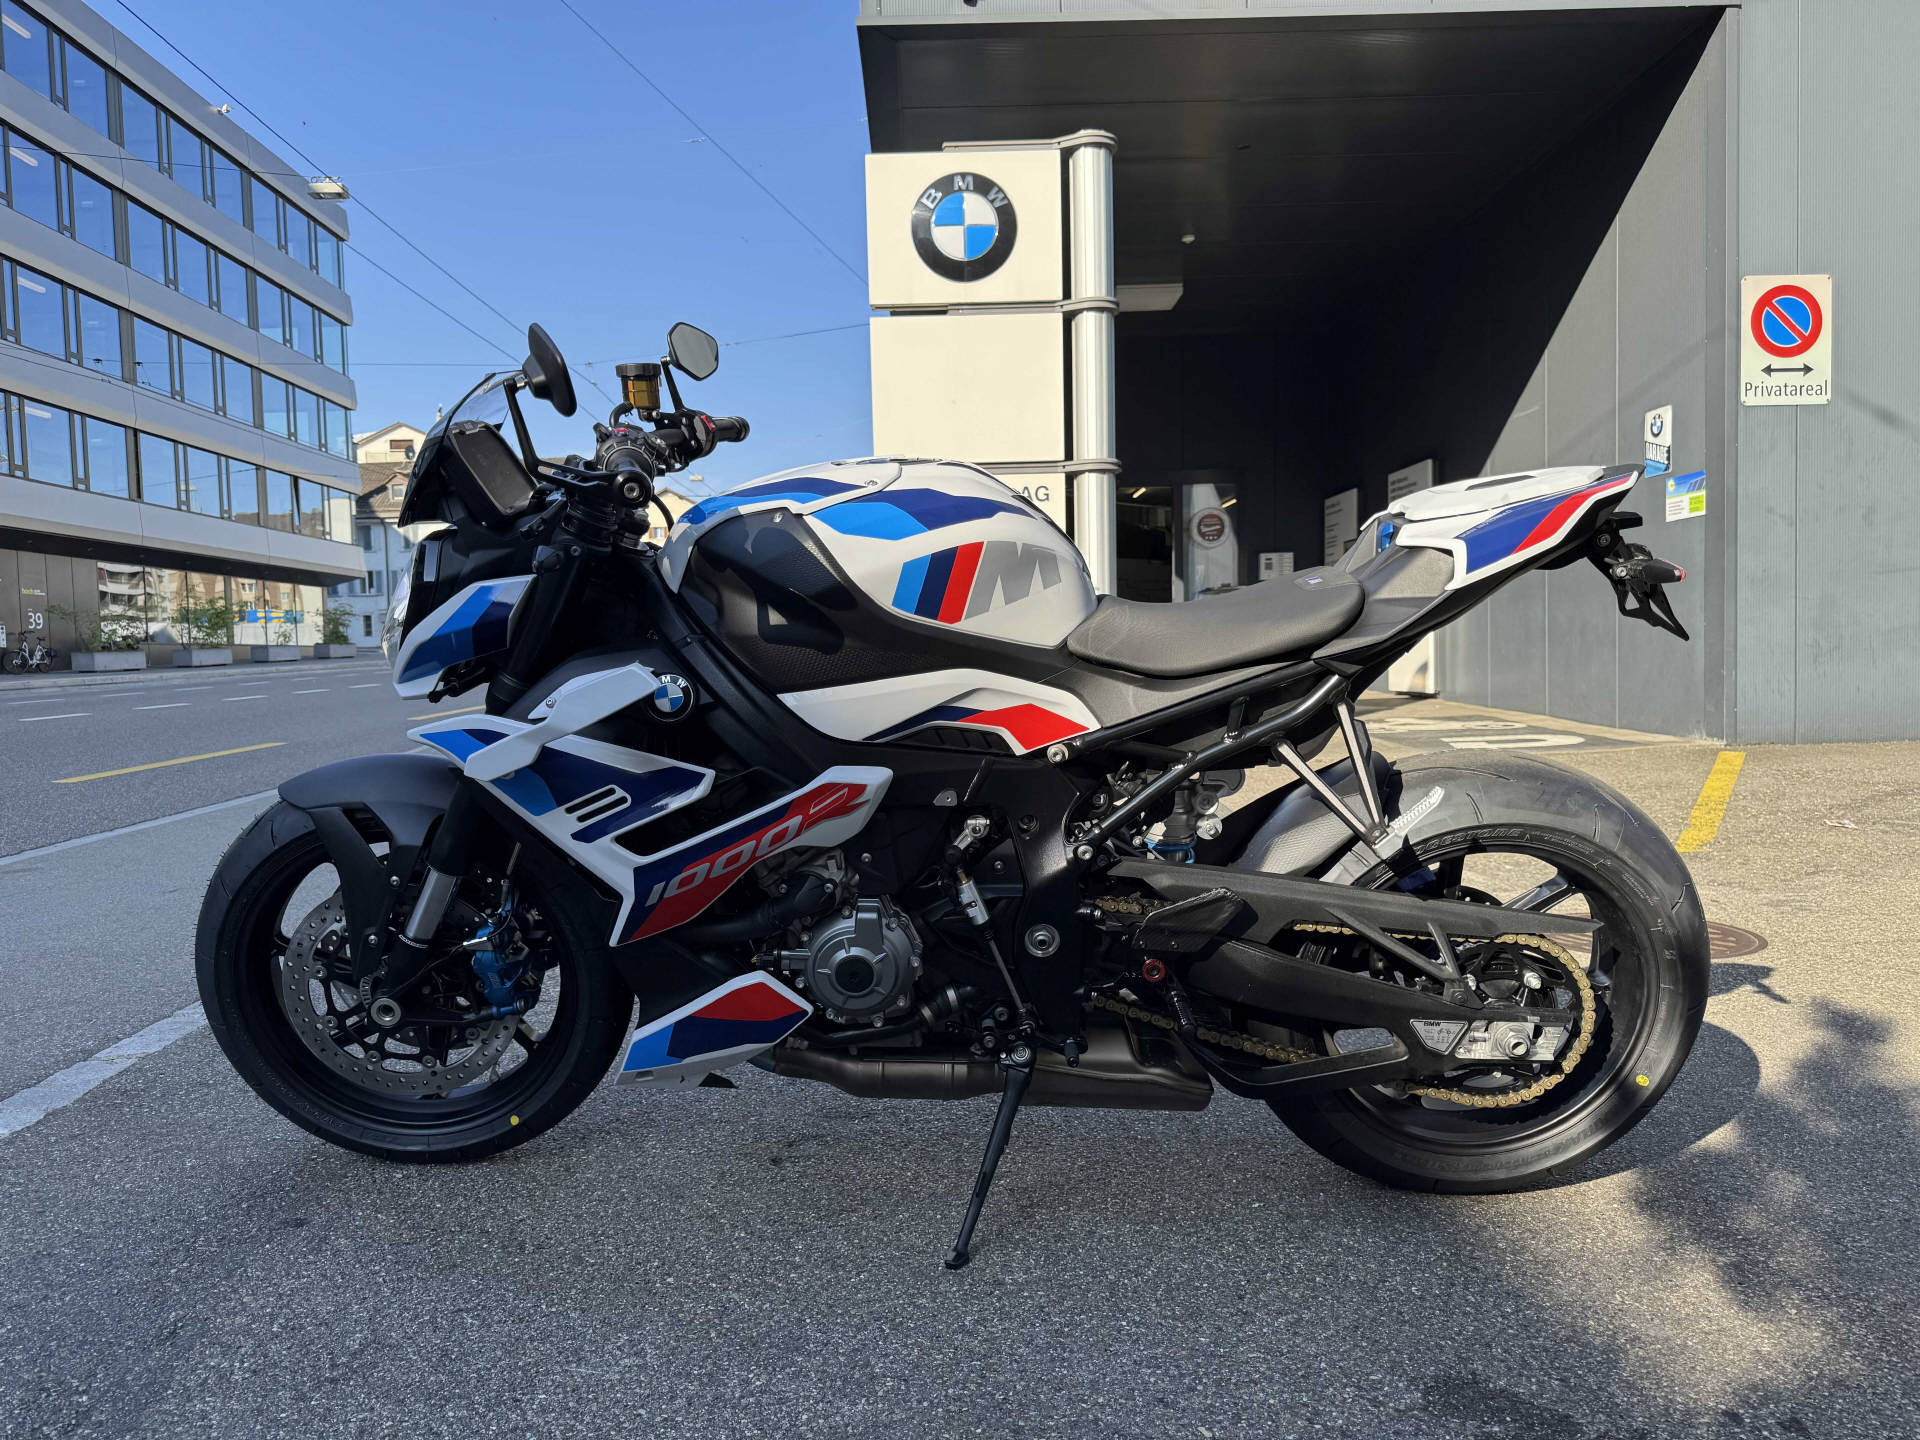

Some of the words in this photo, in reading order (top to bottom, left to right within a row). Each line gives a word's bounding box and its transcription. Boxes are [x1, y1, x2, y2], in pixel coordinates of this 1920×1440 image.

[920, 174, 1008, 209] BMW
[1744, 379, 1828, 397] Privatareal
[1021, 485, 1050, 502] AG
[27, 612, 44, 629] 39
